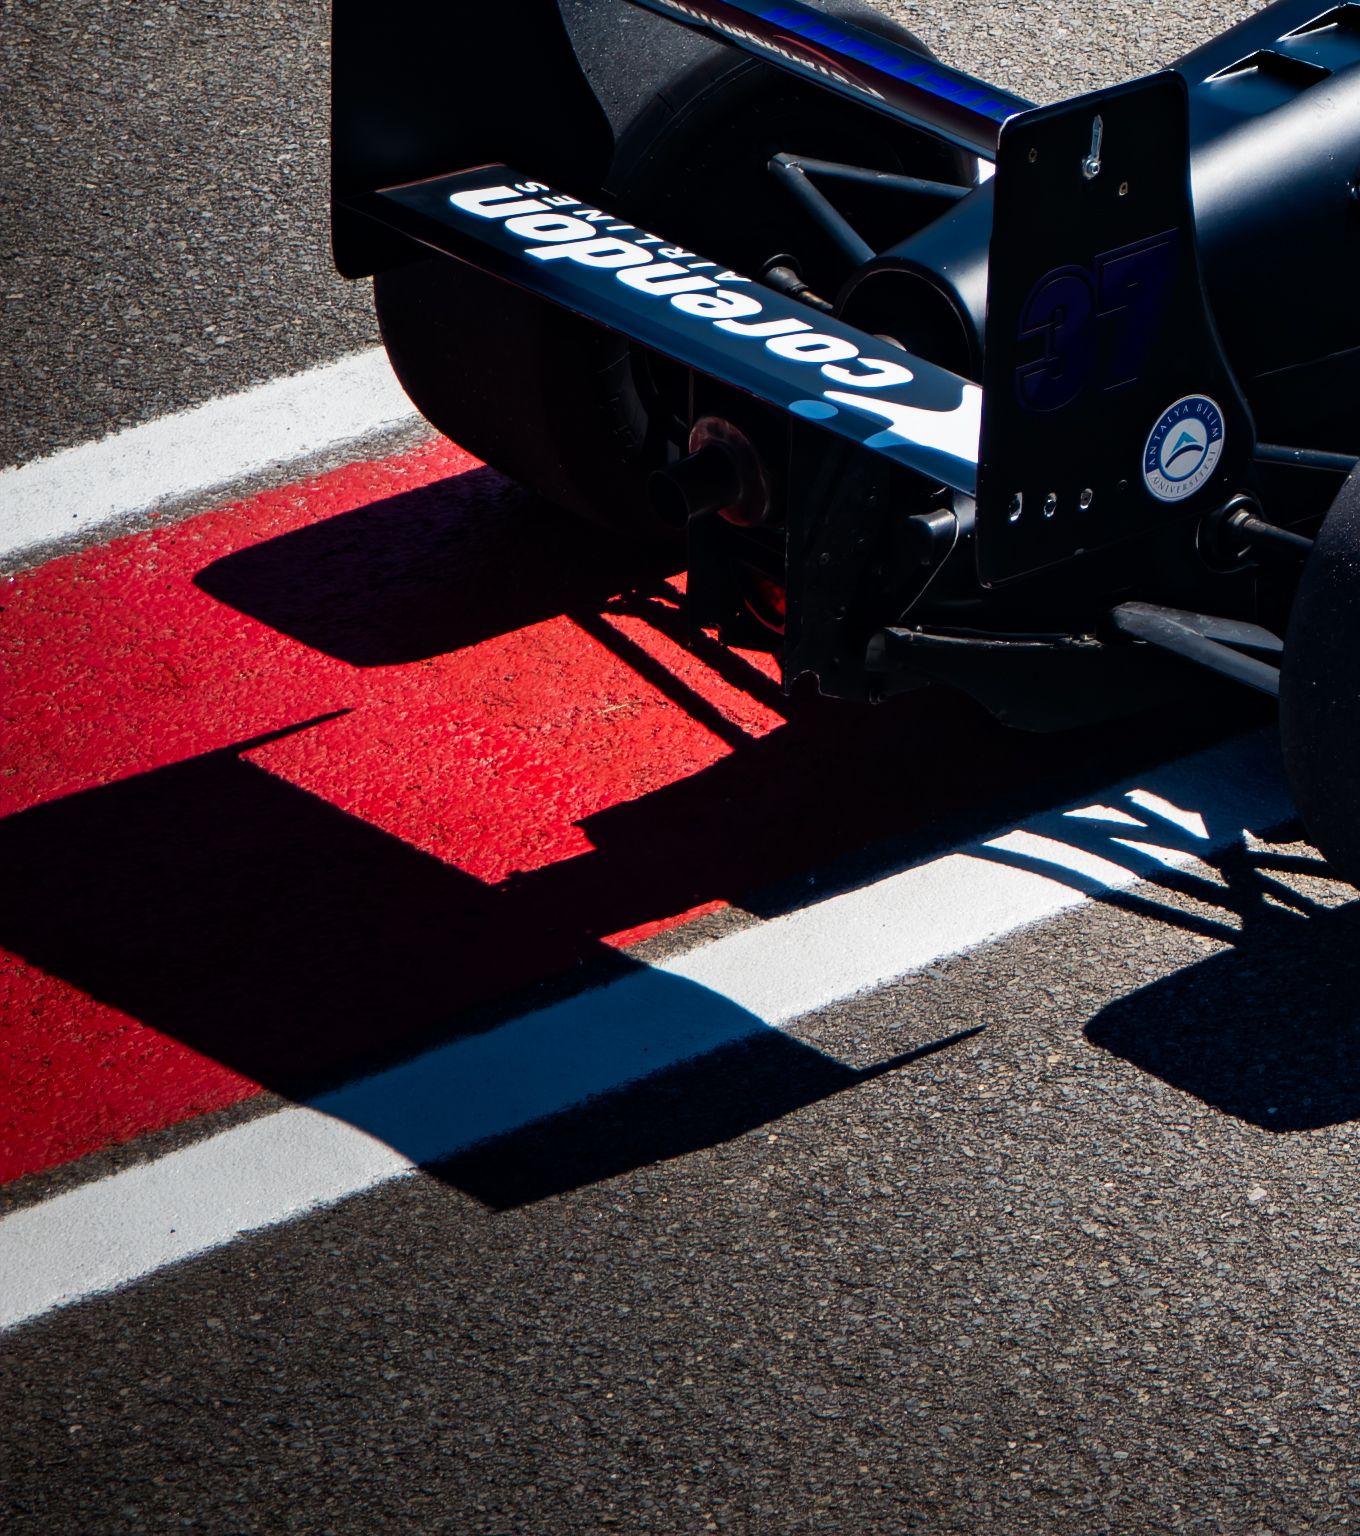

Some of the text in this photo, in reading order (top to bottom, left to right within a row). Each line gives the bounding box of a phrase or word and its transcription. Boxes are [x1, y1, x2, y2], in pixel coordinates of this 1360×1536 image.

[448, 185, 915, 389] corendon
[513, 180, 753, 285] AIRLINES
[1015, 226, 1181, 415] 37
[1149, 403, 1190, 466] ANTALYA
